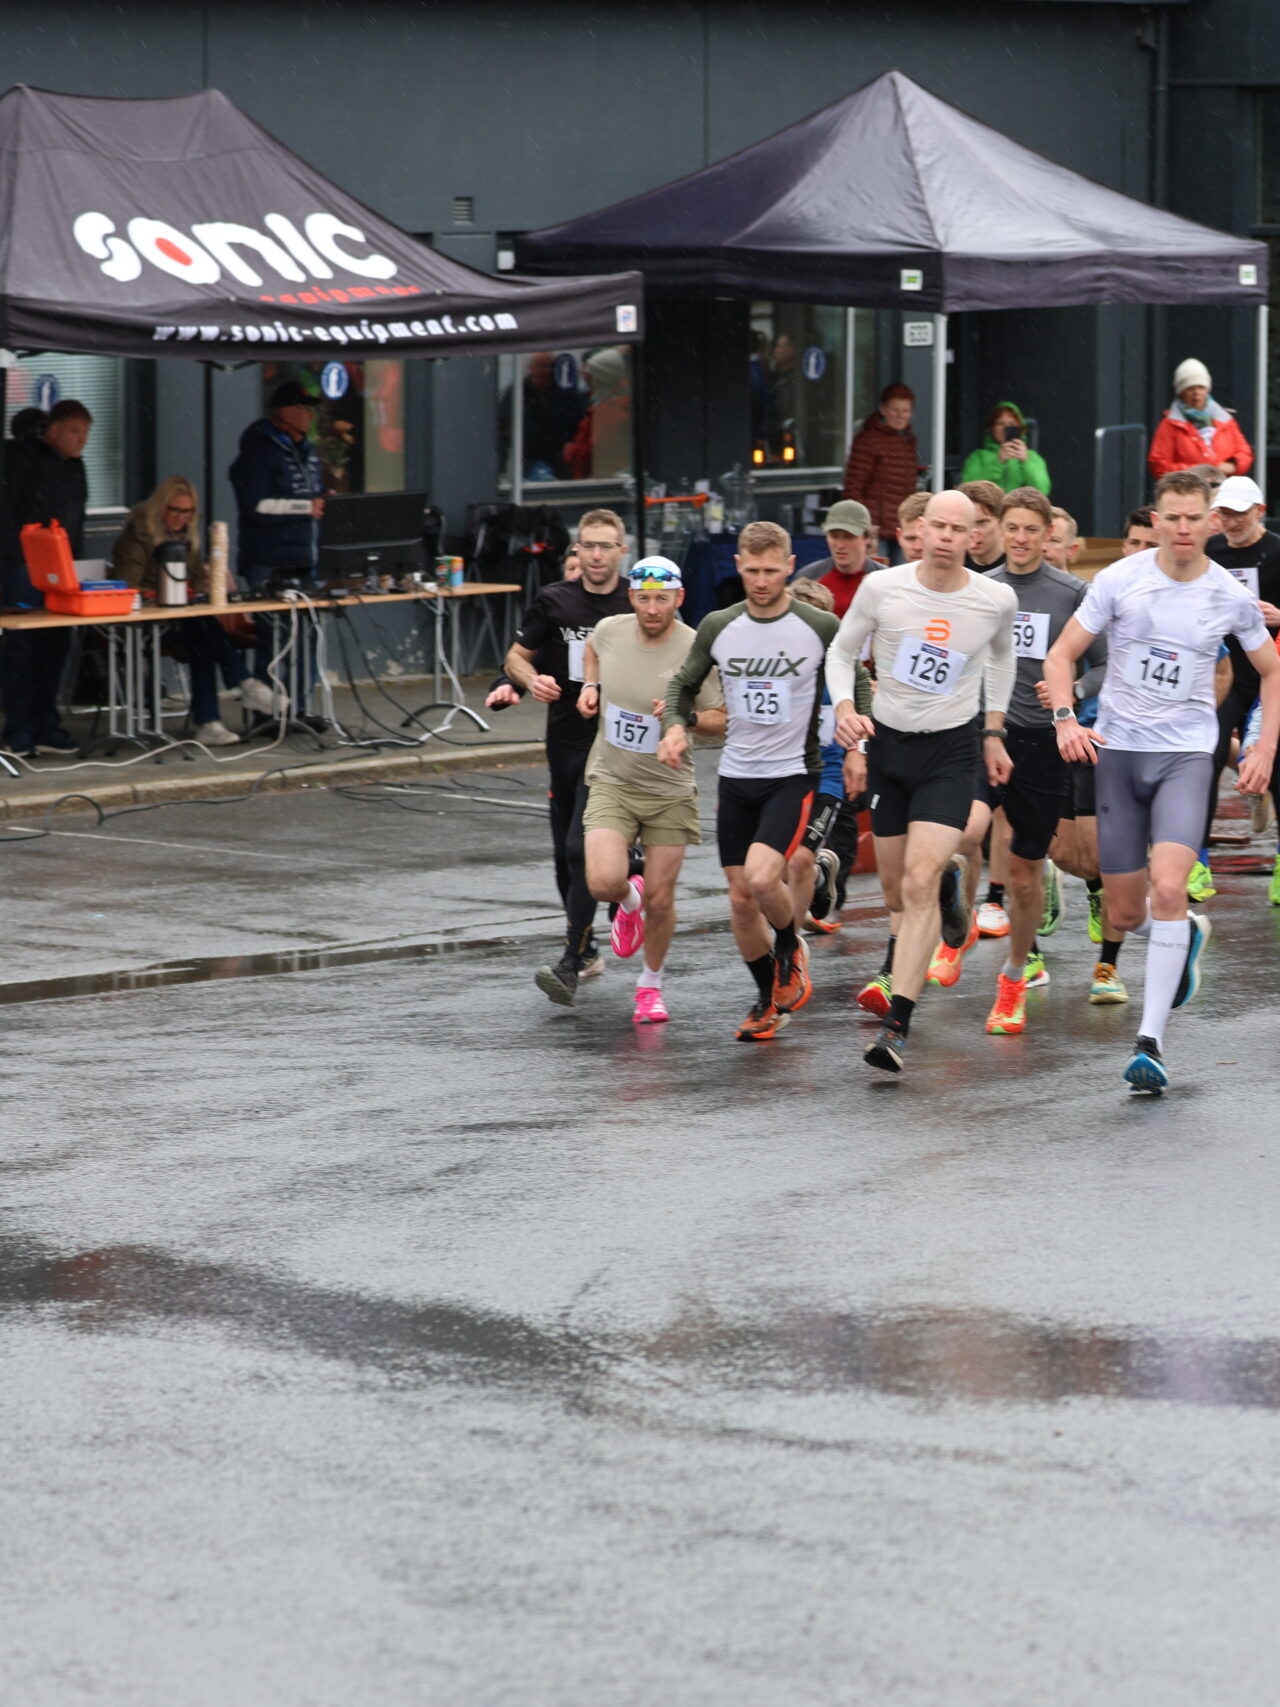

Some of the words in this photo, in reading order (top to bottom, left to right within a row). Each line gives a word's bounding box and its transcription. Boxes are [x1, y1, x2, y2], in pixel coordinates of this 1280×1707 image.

[153, 313, 518, 345] www.sonic-equipment.com
[909, 652, 951, 685] 126
[1141, 658, 1181, 689] 144
[742, 692, 779, 715] 125
[614, 719, 649, 745] 157
